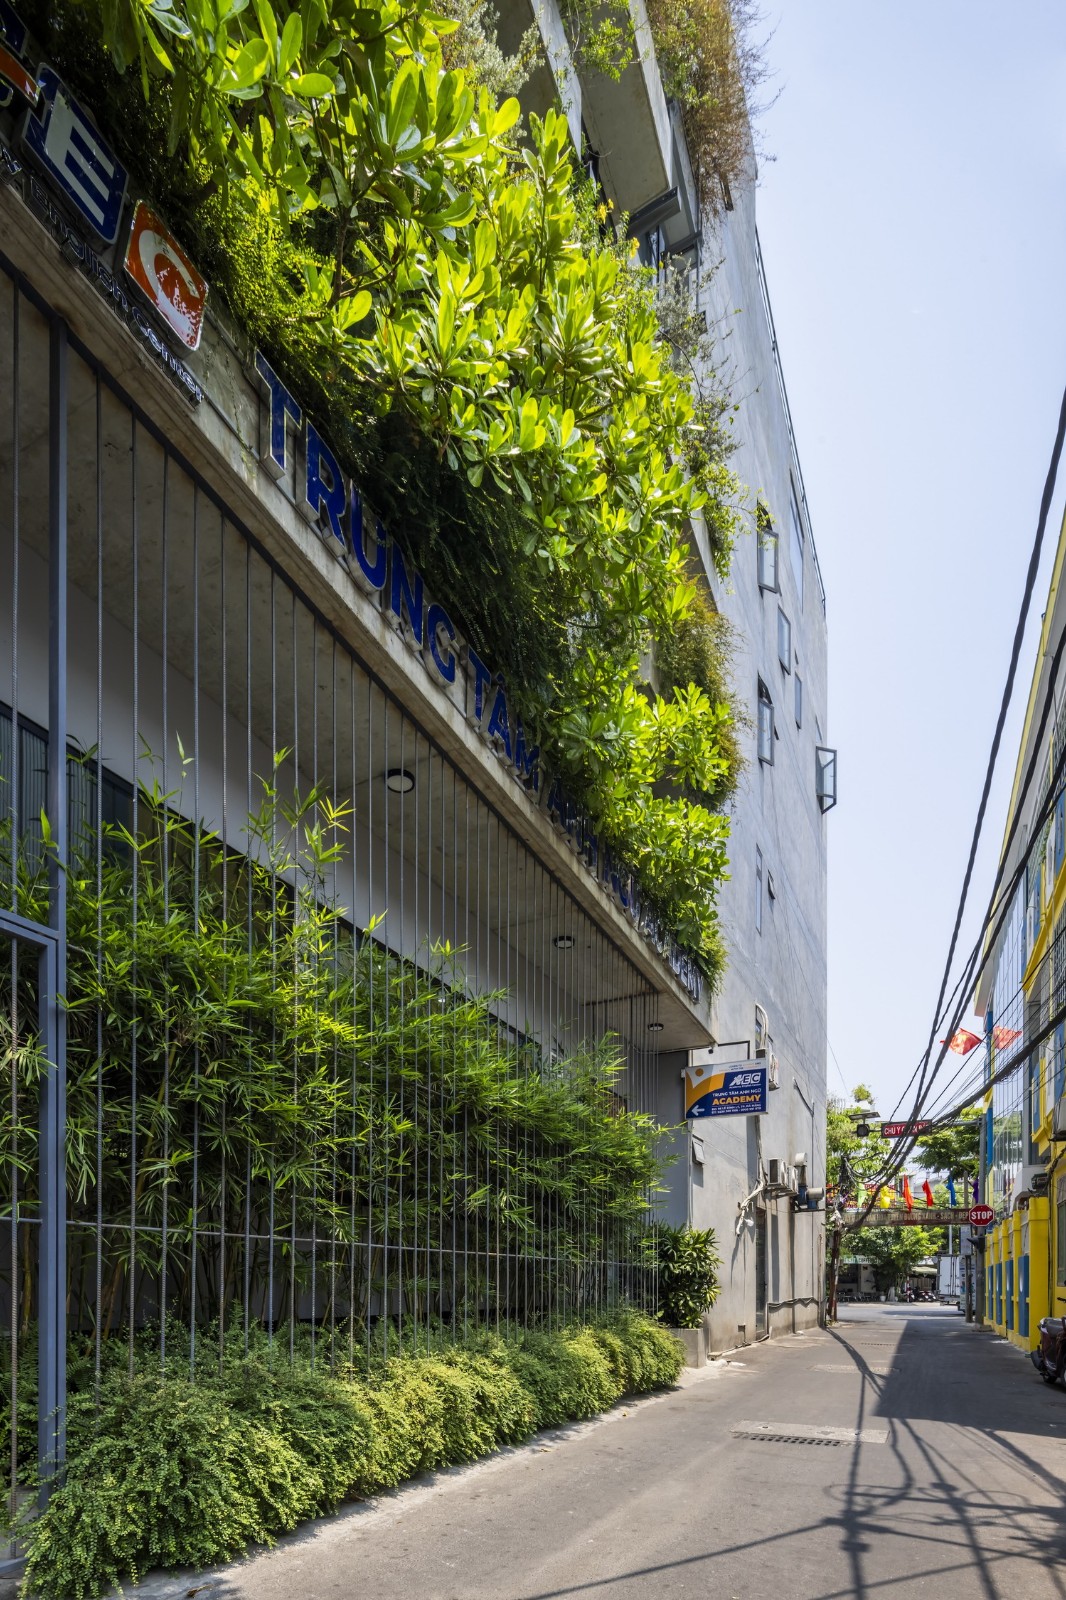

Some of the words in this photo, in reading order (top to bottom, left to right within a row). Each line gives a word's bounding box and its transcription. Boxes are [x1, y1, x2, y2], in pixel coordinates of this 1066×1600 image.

[131, 305, 203, 401] Center
[254, 348, 458, 686] TRUNG
[712, 1094, 761, 1106] ACADEMY
[971, 1210, 993, 1220] STOP
